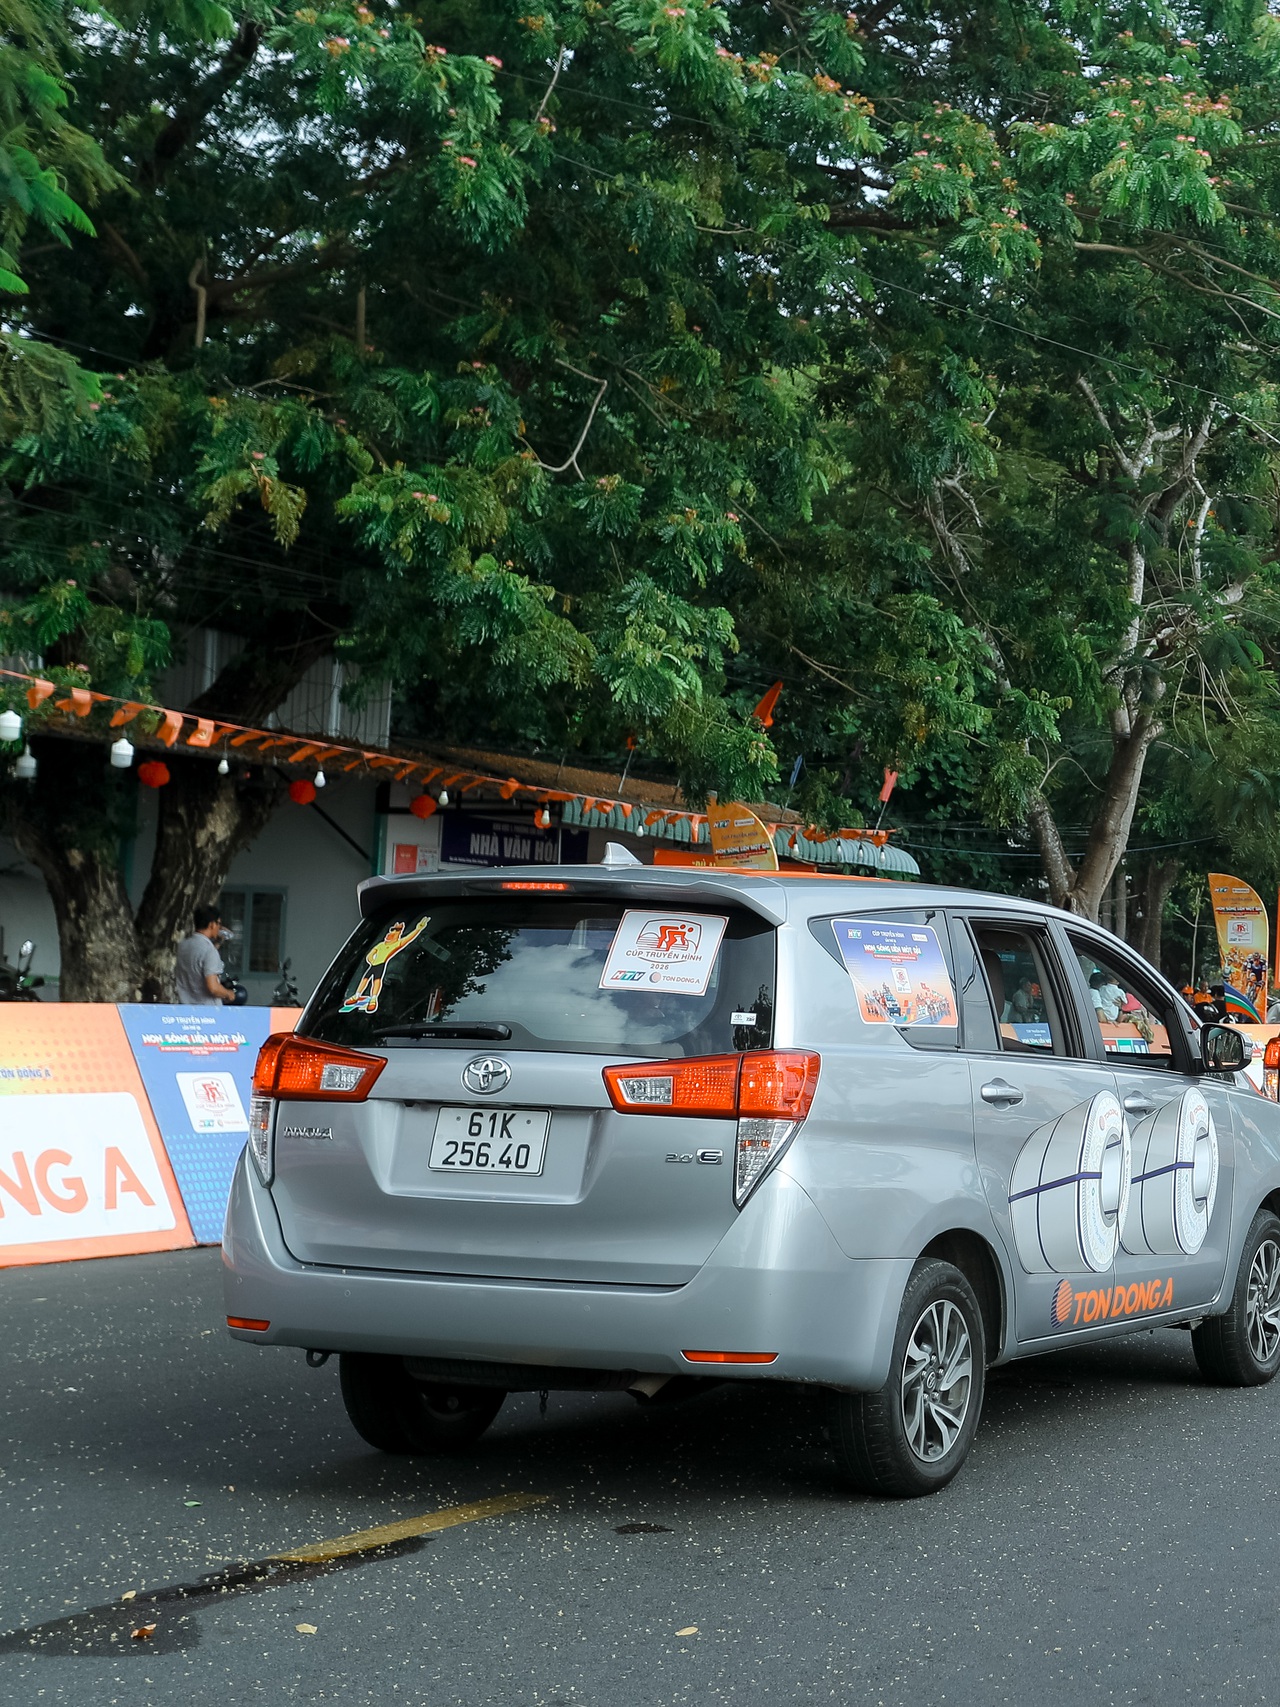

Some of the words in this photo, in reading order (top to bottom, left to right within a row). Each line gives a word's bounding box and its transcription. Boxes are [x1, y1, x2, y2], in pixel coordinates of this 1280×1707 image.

[610, 970, 646, 981] HTV
[468, 1111, 516, 1139] 61K
[441, 1140, 531, 1169] 256.40
[104, 1146, 156, 1210] A
[1073, 1288, 1113, 1325] TON
[1110, 1279, 1162, 1318] DONG
[1159, 1277, 1174, 1307] A
